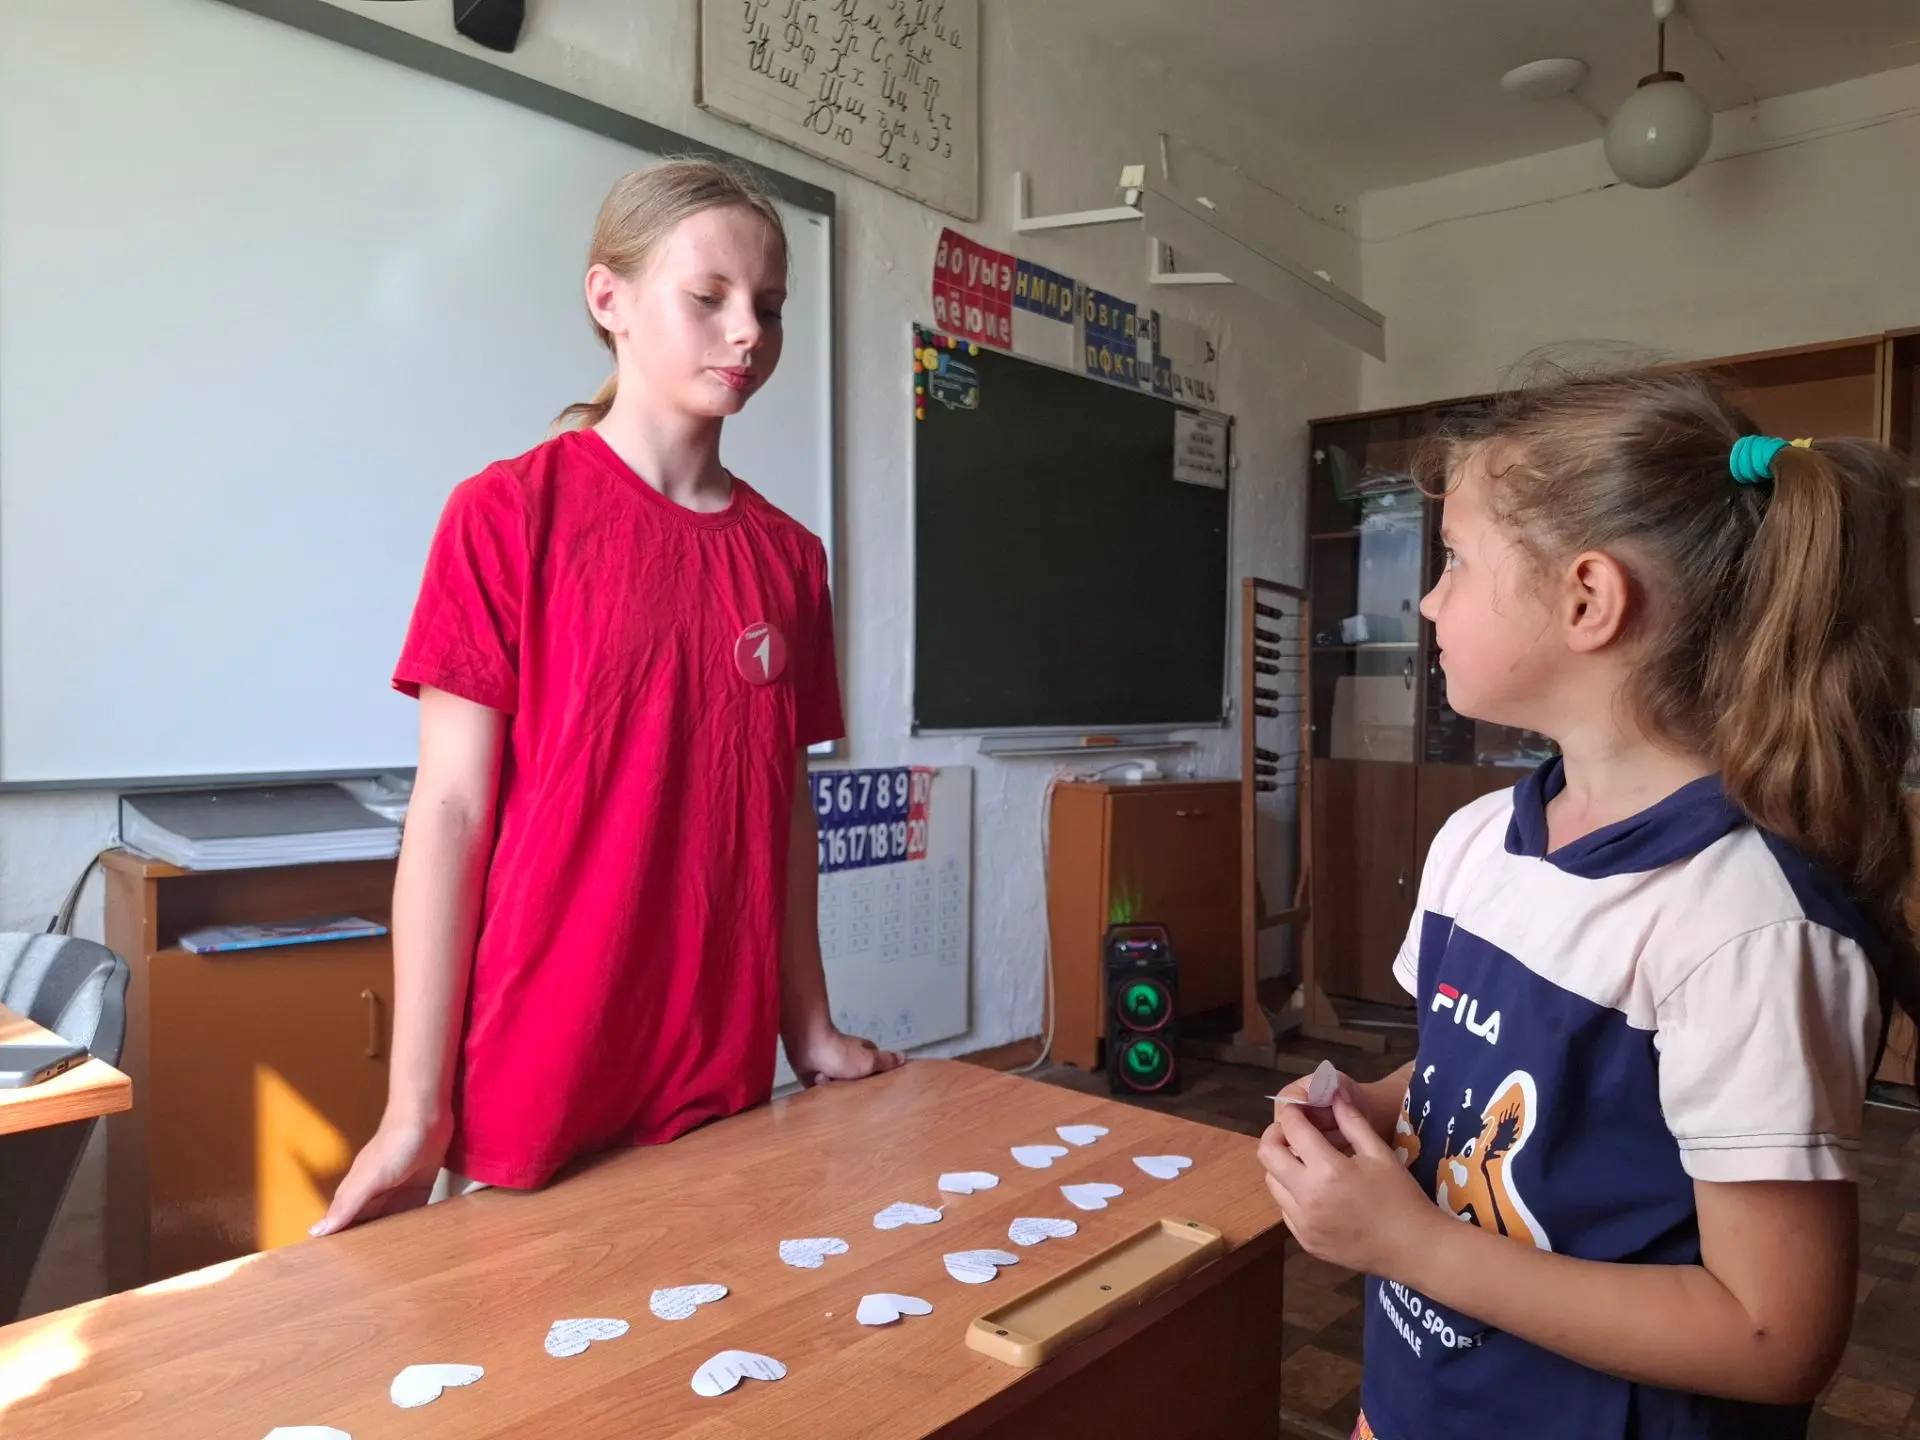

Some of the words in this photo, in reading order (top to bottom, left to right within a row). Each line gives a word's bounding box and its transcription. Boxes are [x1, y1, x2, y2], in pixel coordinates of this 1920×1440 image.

[818, 777, 833, 815] 5
[837, 775, 853, 813] 6
[857, 774, 872, 811] 7
[876, 773, 891, 809] 8
[895, 772, 909, 808] 9
[912, 771, 931, 804] 10
[826, 827, 848, 865] 16
[847, 825, 867, 861] 17
[868, 822, 889, 859] 18
[888, 820, 907, 857] 19
[907, 819, 926, 853] 20
[1431, 982, 1500, 1046] FILA
